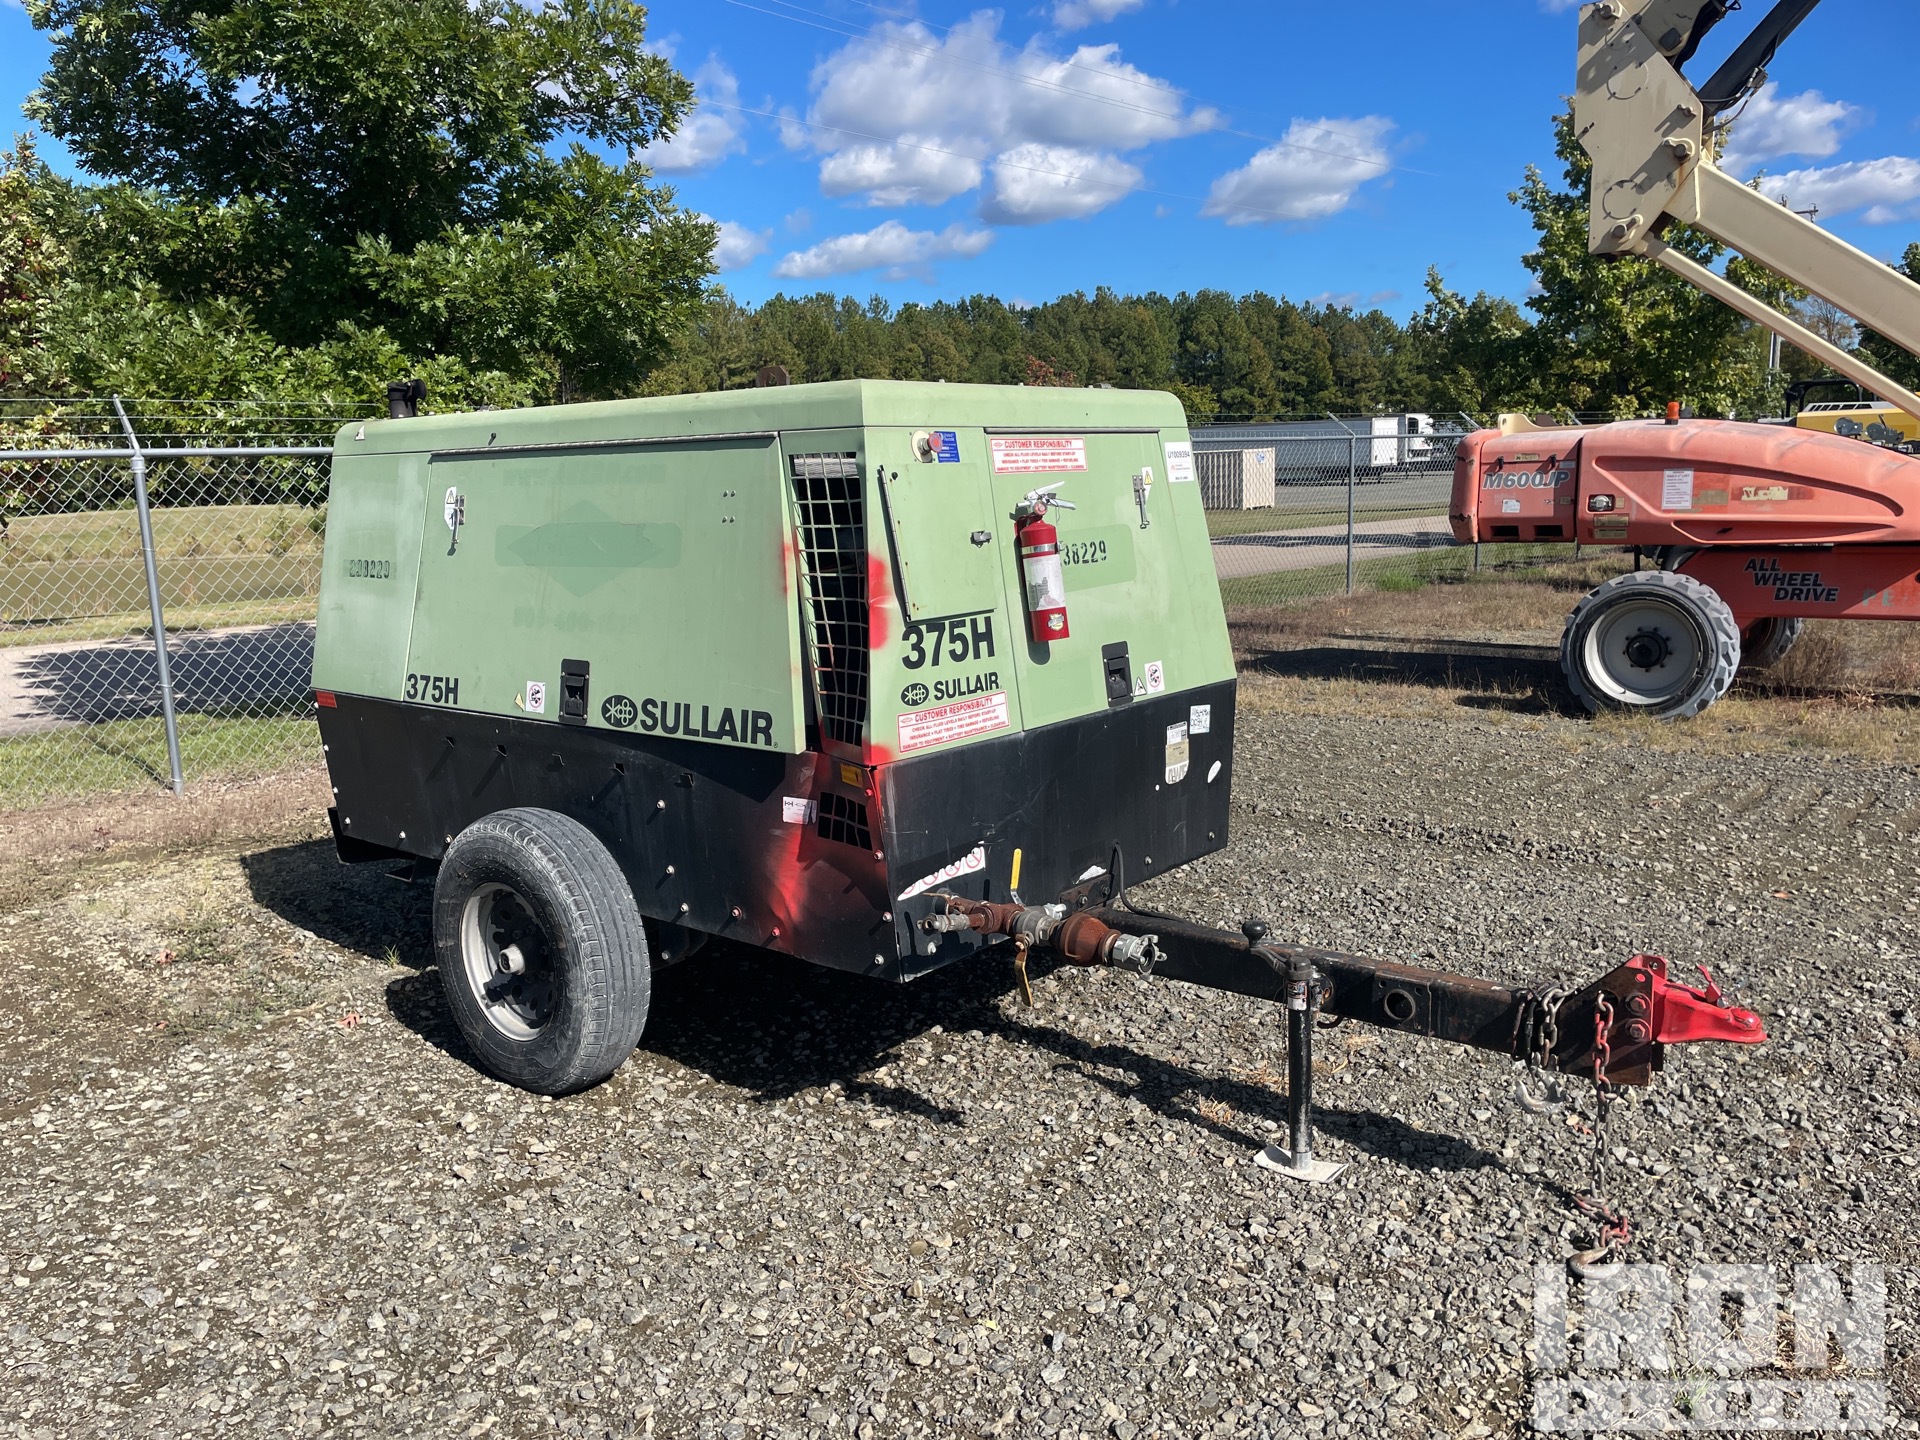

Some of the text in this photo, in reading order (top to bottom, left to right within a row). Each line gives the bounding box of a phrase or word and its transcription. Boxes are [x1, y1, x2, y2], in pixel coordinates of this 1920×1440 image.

[1482, 470, 1570, 489] M600JP
[1060, 540, 1107, 567] 38229
[1744, 557, 1781, 572] ALL
[1754, 572, 1824, 587] WHEEL
[1774, 587, 1840, 602] DRIVE
[902, 616, 995, 670] 375H
[406, 673, 459, 705] 375H
[934, 672, 1000, 701] SULLAIR
[640, 698, 773, 746] SULLAIR
[914, 698, 993, 722] CUSTOMER RESPONSIBILITY
